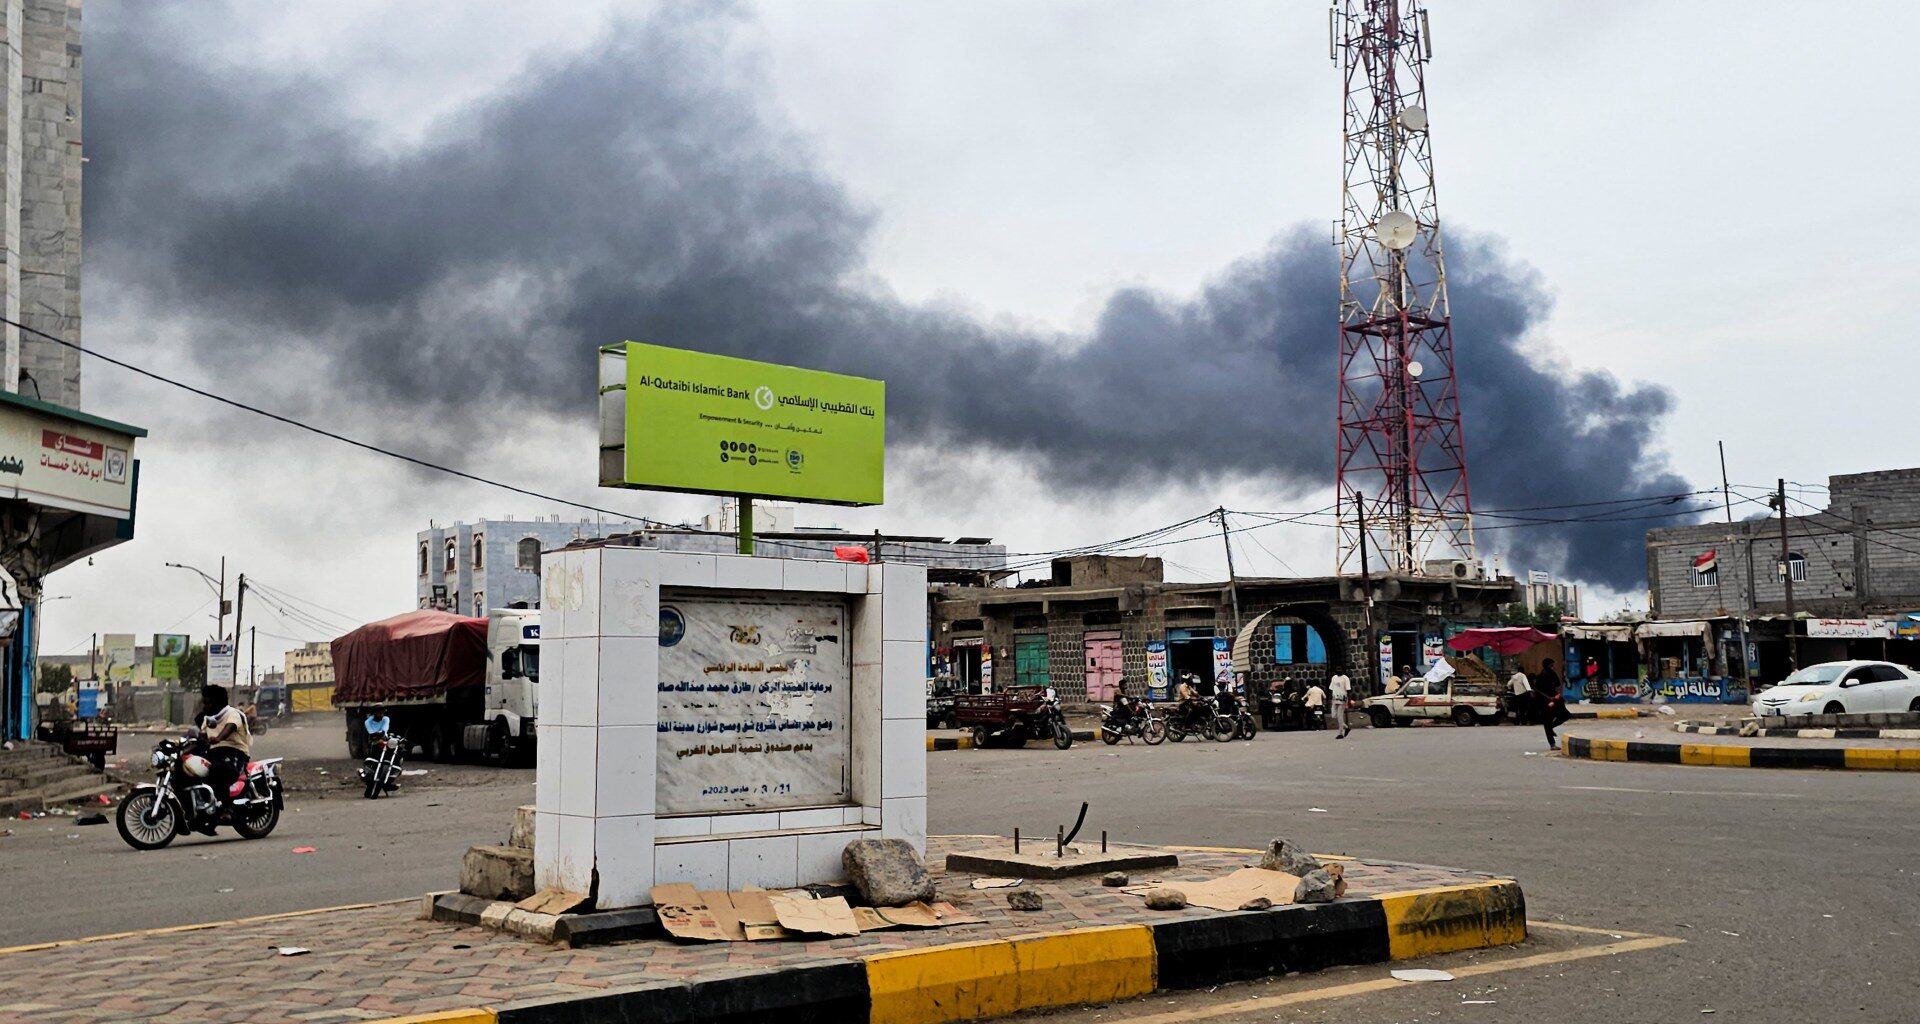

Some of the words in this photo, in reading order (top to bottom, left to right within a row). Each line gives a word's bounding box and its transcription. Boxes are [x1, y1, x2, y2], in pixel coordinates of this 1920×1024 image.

[640, 375, 690, 392] Al-Qutaibi
[692, 383, 725, 397] Islamic
[727, 387, 750, 400] Bank
[777, 394, 818, 411] الإسلامي
[820, 402, 858, 414] القطيبي
[859, 405, 875, 419] بنك
[699, 413, 737, 422] Empowerment
[743, 418, 763, 427] Security
[707, 684, 730, 692] محمد
[731, 681, 751, 694] طارق
[1675, 681, 1689, 699] ابو
[1688, 681, 1721, 700] بقالة
[673, 720, 695, 734] مدينة
[697, 720, 718, 733] شوارع
[801, 720, 816, 731] حجر
[817, 718, 833, 731] وضع
[676, 744, 706, 760] الغربي
[707, 743, 737, 756] الساحل
[739, 743, 762, 755] تنمية
[764, 742, 792, 754] صندوق
[793, 743, 813, 753] بدعم
[730, 785, 749, 794] مارس
